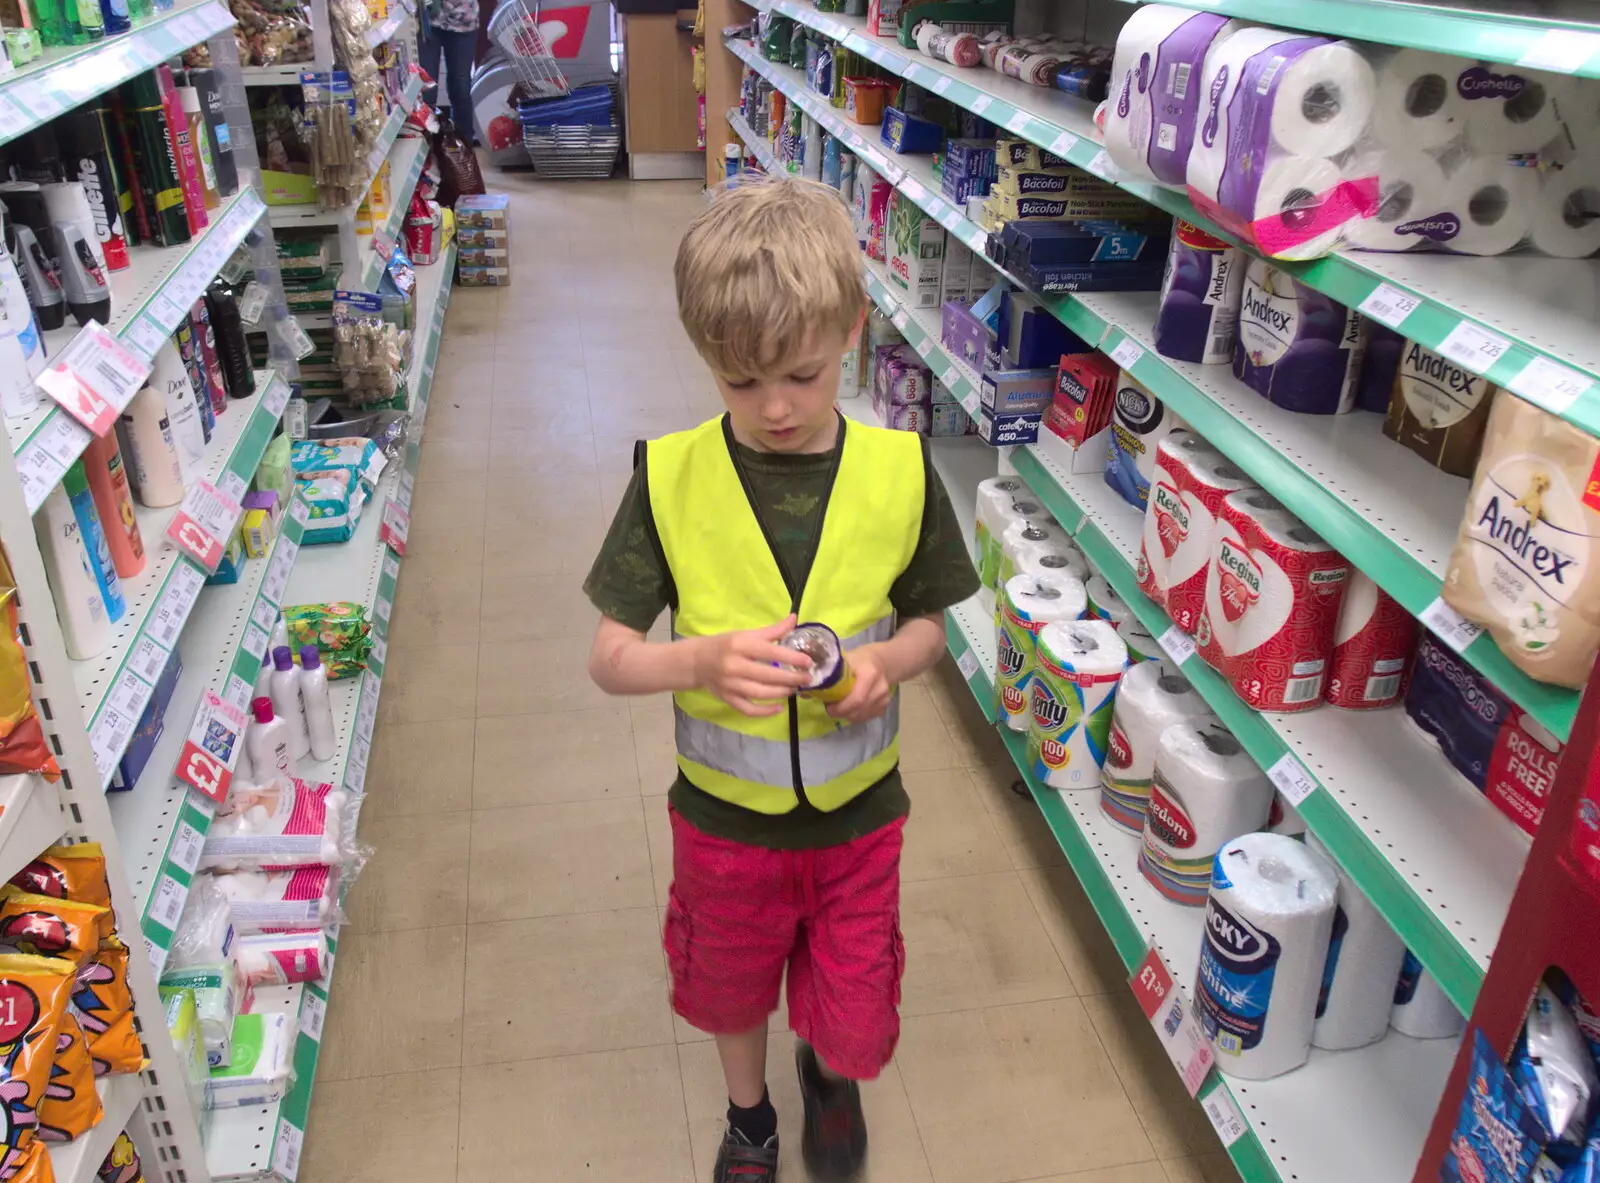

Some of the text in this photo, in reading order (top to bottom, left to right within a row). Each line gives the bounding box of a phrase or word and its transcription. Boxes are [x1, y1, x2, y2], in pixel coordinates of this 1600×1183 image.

[1460, 75, 1524, 91] Cushelle
[1022, 177, 1065, 189] Bacofoil
[77, 157, 112, 243] Gillette
[1021, 202, 1064, 214] Bacofoil
[891, 255, 910, 281] ARIEL
[1210, 258, 1228, 301] Andrex
[1243, 287, 1291, 334] Andrex
[1395, 298, 1415, 313] 2.25
[1479, 341, 1501, 358] 2.25
[1405, 343, 1475, 396] Andrex
[167, 376, 187, 395] Dove
[907, 378, 917, 400] Bold
[1060, 375, 1086, 402] Bacofoil
[997, 432, 1016, 442] 450
[1156, 487, 1190, 530] Regina
[178, 521, 215, 558] £2
[1478, 496, 1572, 584] Andrex
[1220, 545, 1261, 592] Regina
[1312, 571, 1345, 582] Regina
[1181, 610, 1191, 624] 2
[1458, 618, 1481, 637] 2.25
[1003, 685, 1022, 701] 100
[1250, 680, 1262, 693] 2
[1330, 679, 1342, 693] 2
[1043, 739, 1065, 758] 100
[1507, 731, 1559, 782] ROLLS
[186, 754, 224, 796] £2
[1507, 756, 1549, 799] FREE
[1139, 965, 1166, 998] £1.29
[1200, 954, 1246, 1010] Shine
